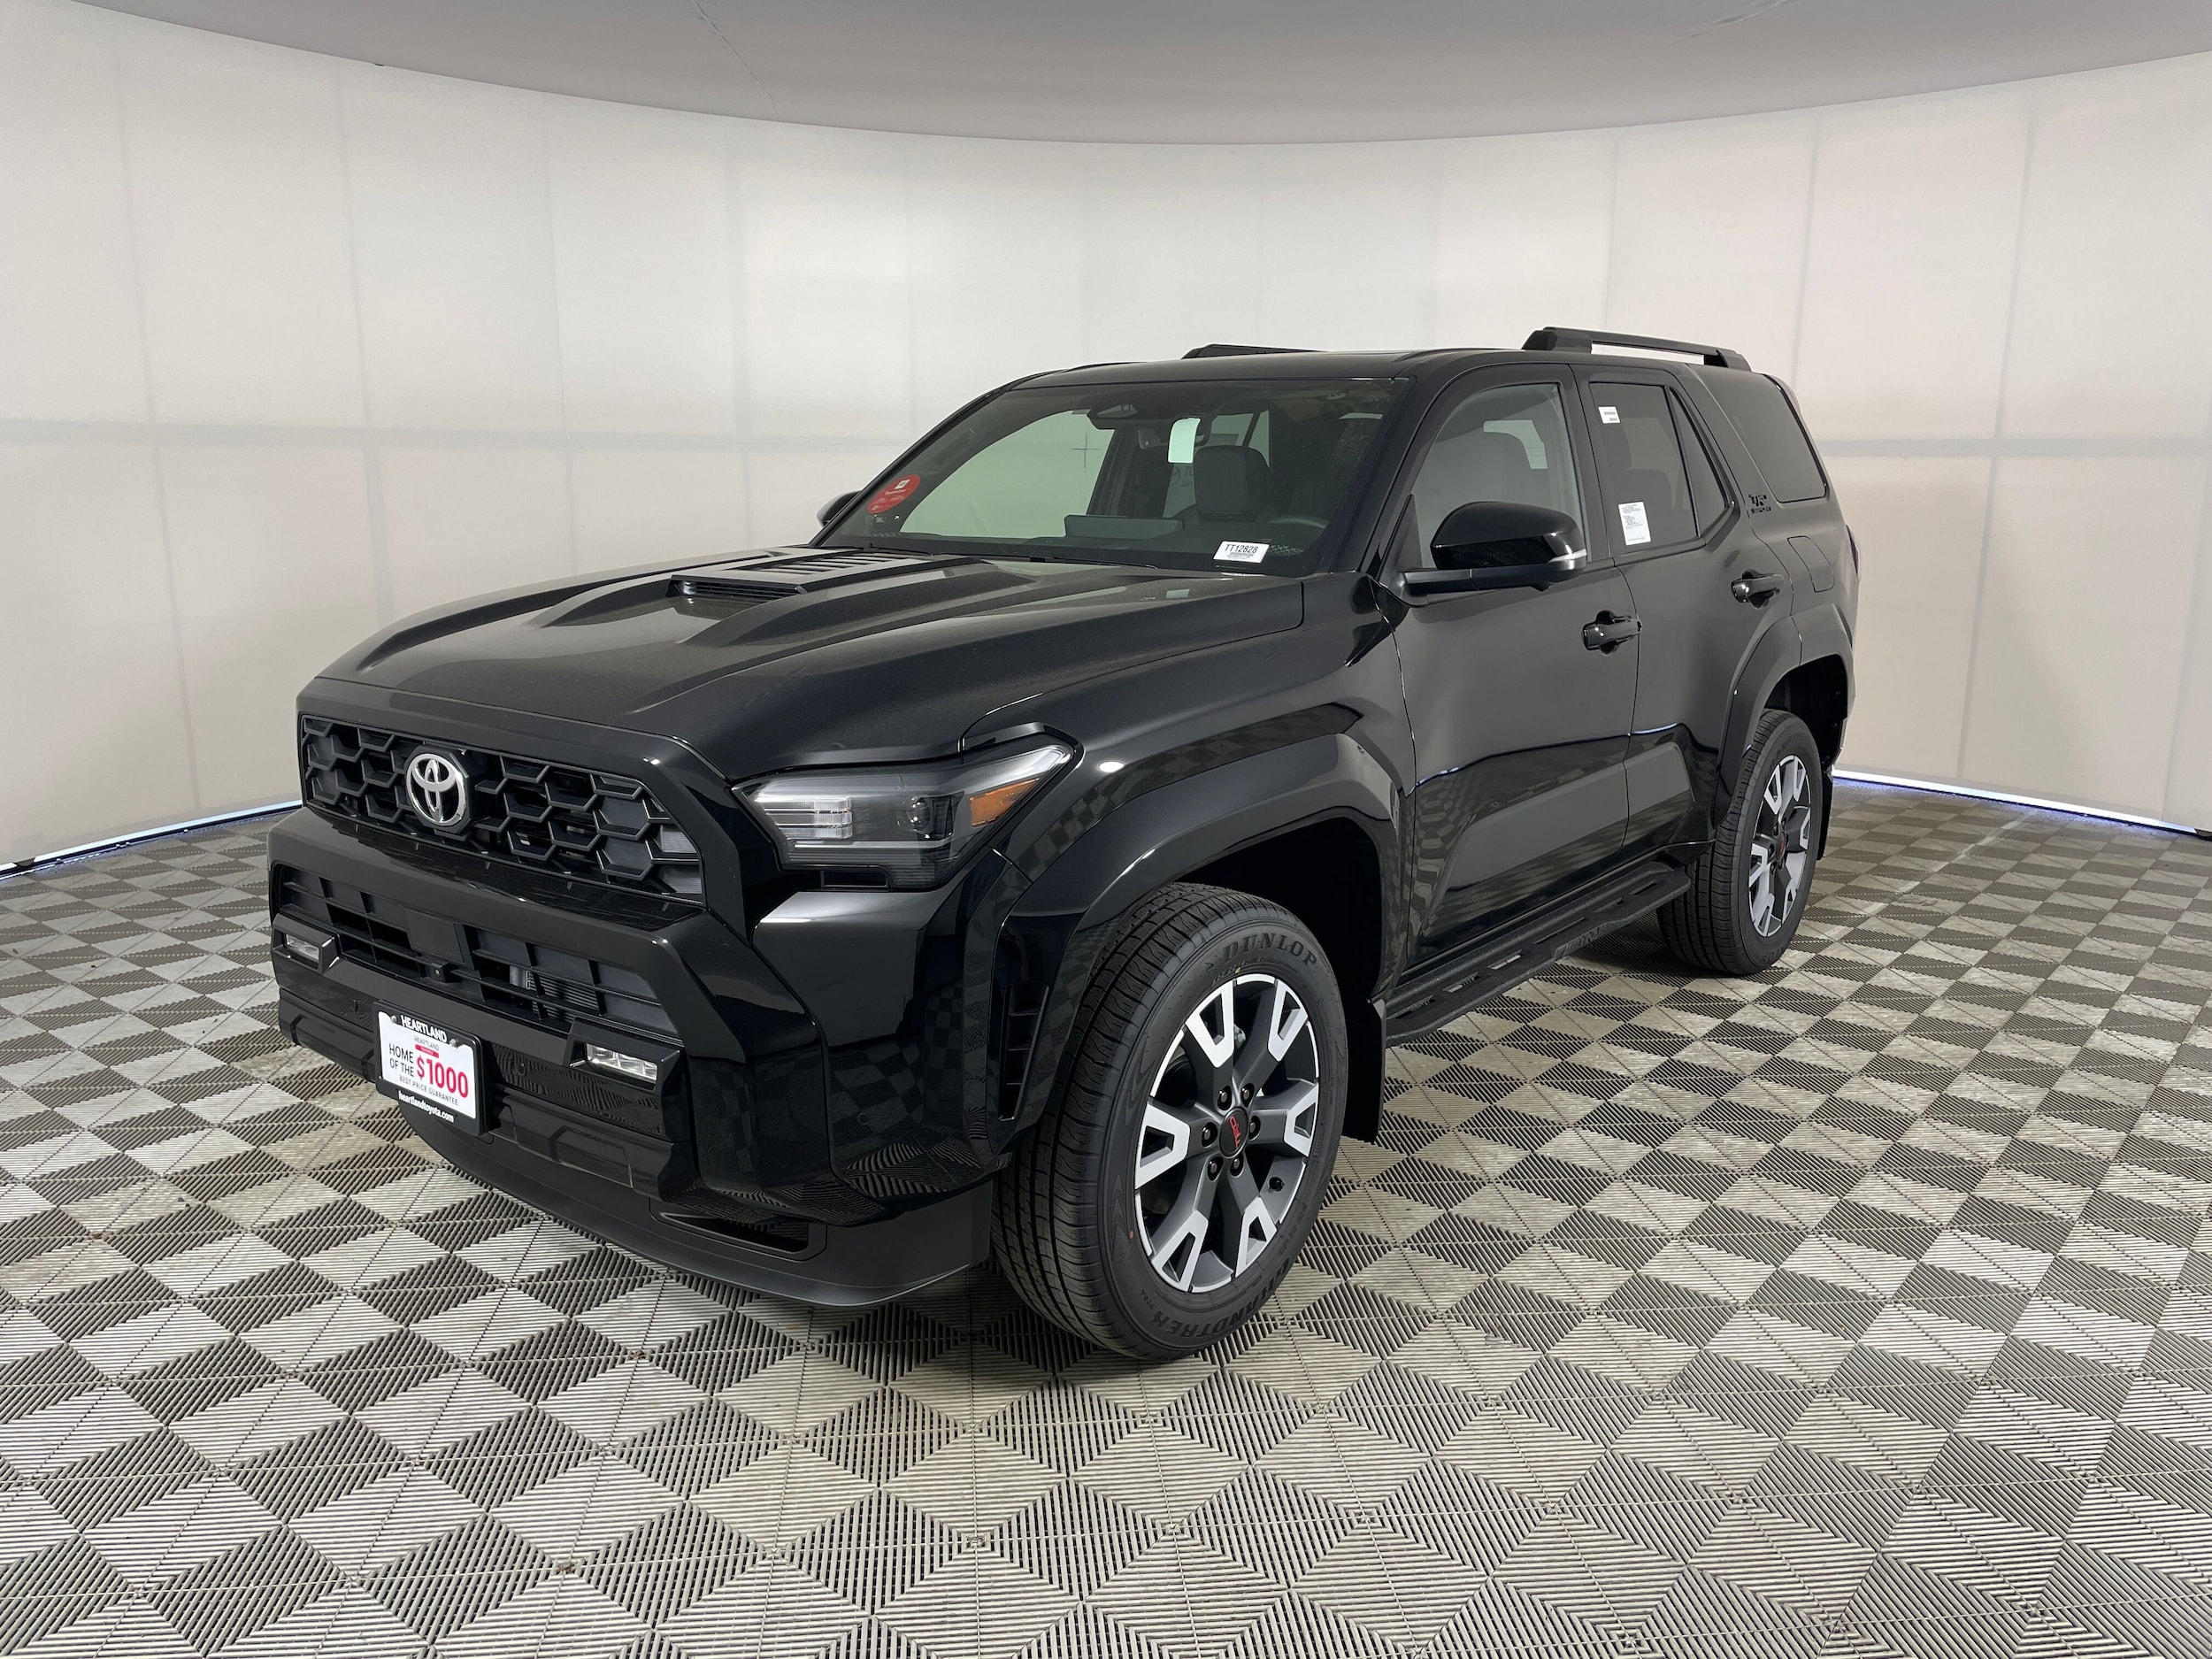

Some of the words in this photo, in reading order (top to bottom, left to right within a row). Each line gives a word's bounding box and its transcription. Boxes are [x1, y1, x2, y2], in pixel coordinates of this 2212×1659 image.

[1225, 543, 1259, 554] TT12828
[1223, 932, 1317, 966] DUNLOP
[400, 1014, 448, 1043] HEARTLAND
[388, 1042, 414, 1064] HOME
[414, 1036, 440, 1051] HEARTLAND
[389, 1057, 399, 1070] OF
[401, 1063, 415, 1078] THE
[416, 1055, 469, 1099] $1000
[399, 1075, 411, 1087] BEST
[412, 1080, 427, 1094] PRICE
[428, 1086, 458, 1106] GUARANTEE
[398, 1090, 455, 1123] heartlandtoyota.com
